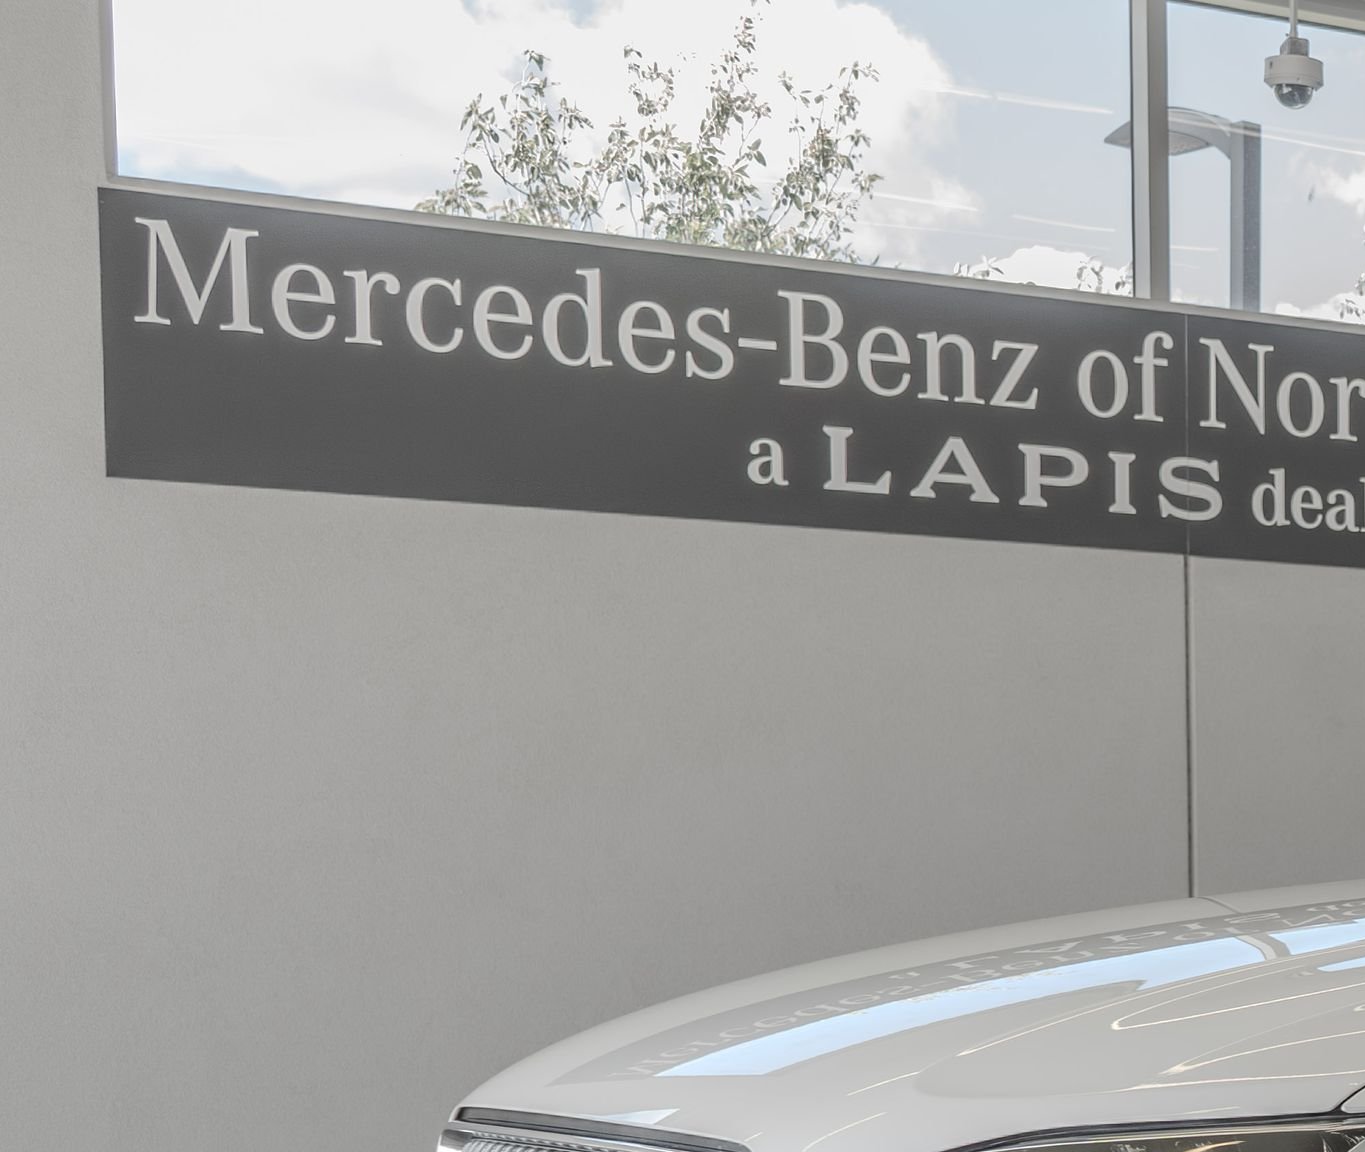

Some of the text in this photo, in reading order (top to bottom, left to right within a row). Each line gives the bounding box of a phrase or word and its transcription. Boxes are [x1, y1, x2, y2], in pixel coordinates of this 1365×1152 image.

[133, 216, 1039, 411] Mercedes-Benz
[1077, 330, 1174, 423] of
[746, 437, 790, 486] a
[822, 424, 1223, 522] LAPIS
